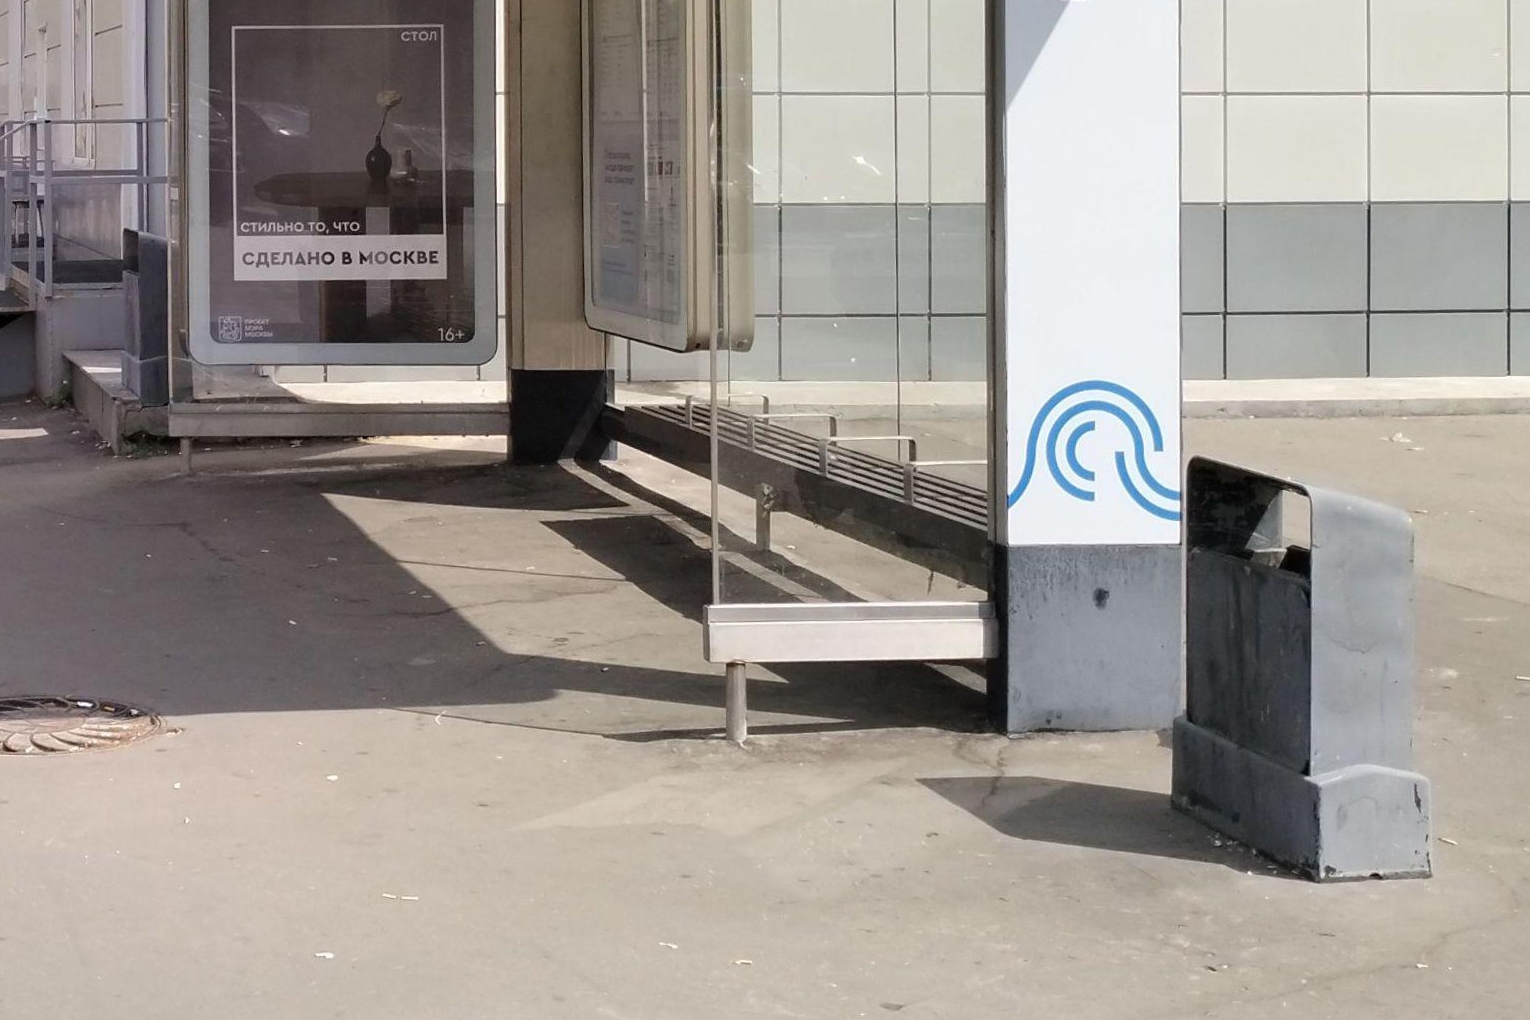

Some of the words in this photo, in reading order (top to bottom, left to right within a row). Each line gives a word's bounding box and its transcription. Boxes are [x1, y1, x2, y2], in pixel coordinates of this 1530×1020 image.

[400, 31, 438, 42] СТОЛ
[240, 221, 304, 233] СТИЛЬНО
[308, 221, 330, 234] ТО,
[333, 221, 361, 232] ЧТО
[242, 251, 335, 268] СДЕЛАНО
[341, 251, 353, 265] В
[358, 250, 440, 266] МОСКВЕ
[437, 326, 466, 342] 16+
